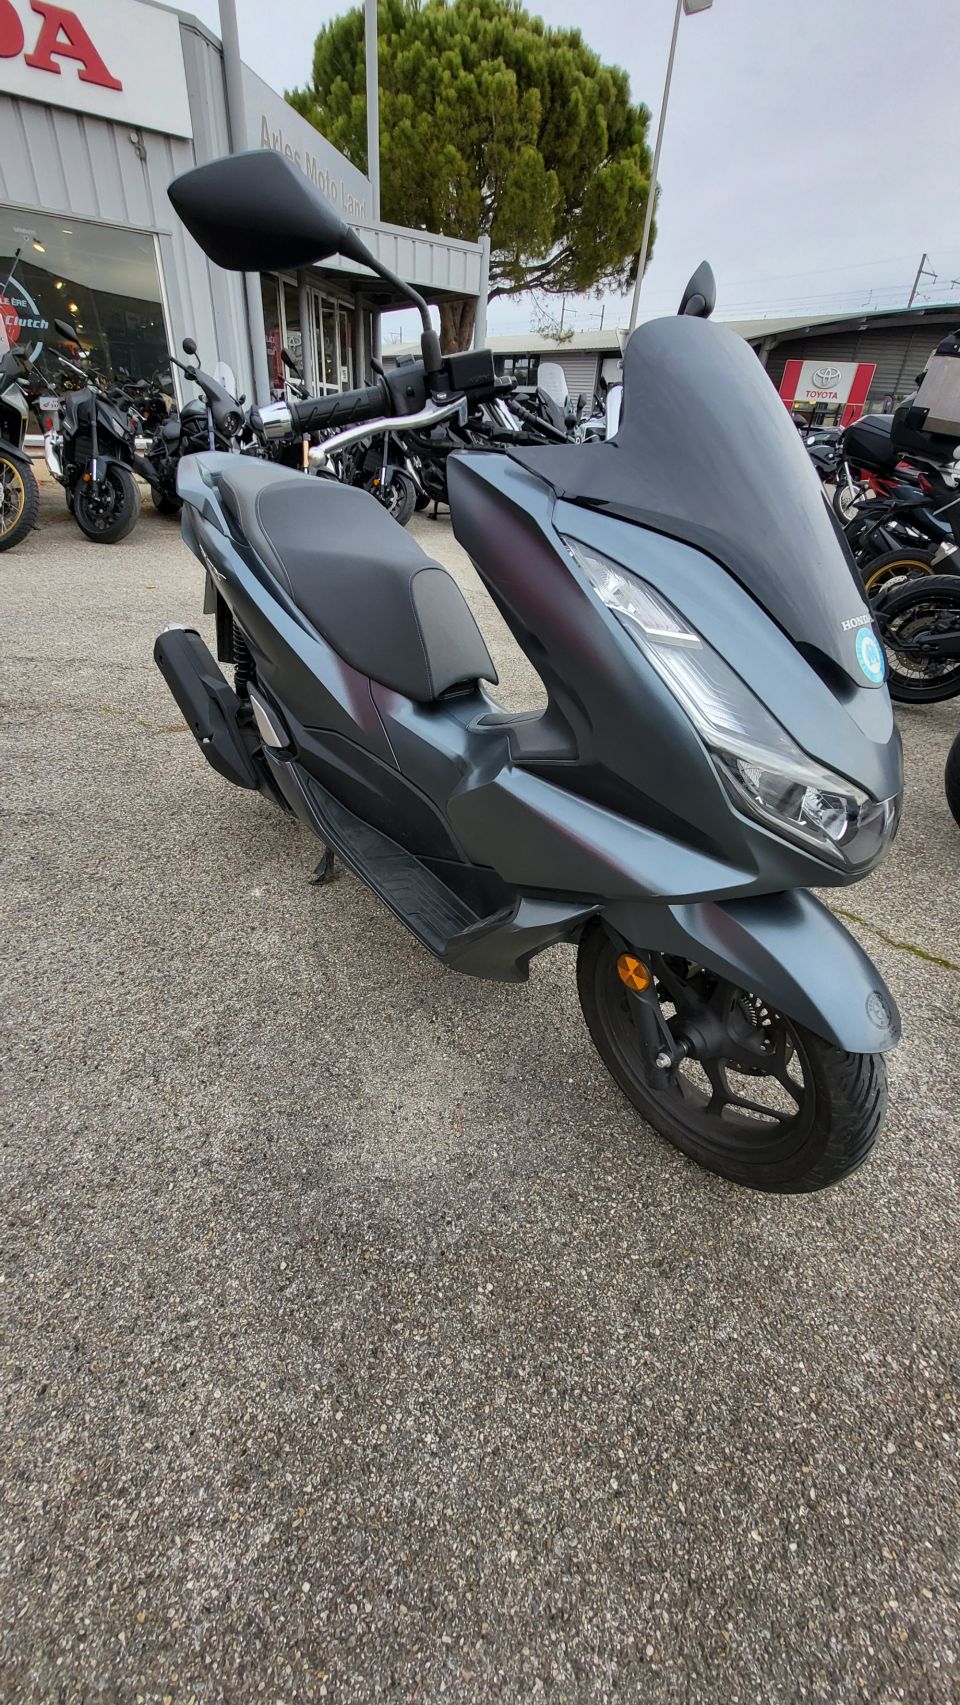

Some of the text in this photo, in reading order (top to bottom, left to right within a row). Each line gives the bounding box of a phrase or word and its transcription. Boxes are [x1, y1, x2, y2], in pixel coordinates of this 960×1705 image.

[305, 152, 338, 204] Moto
[340, 180, 366, 218] Land
[5, 315, 49, 329] Clutch
[806, 390, 838, 399] TOYOTA
